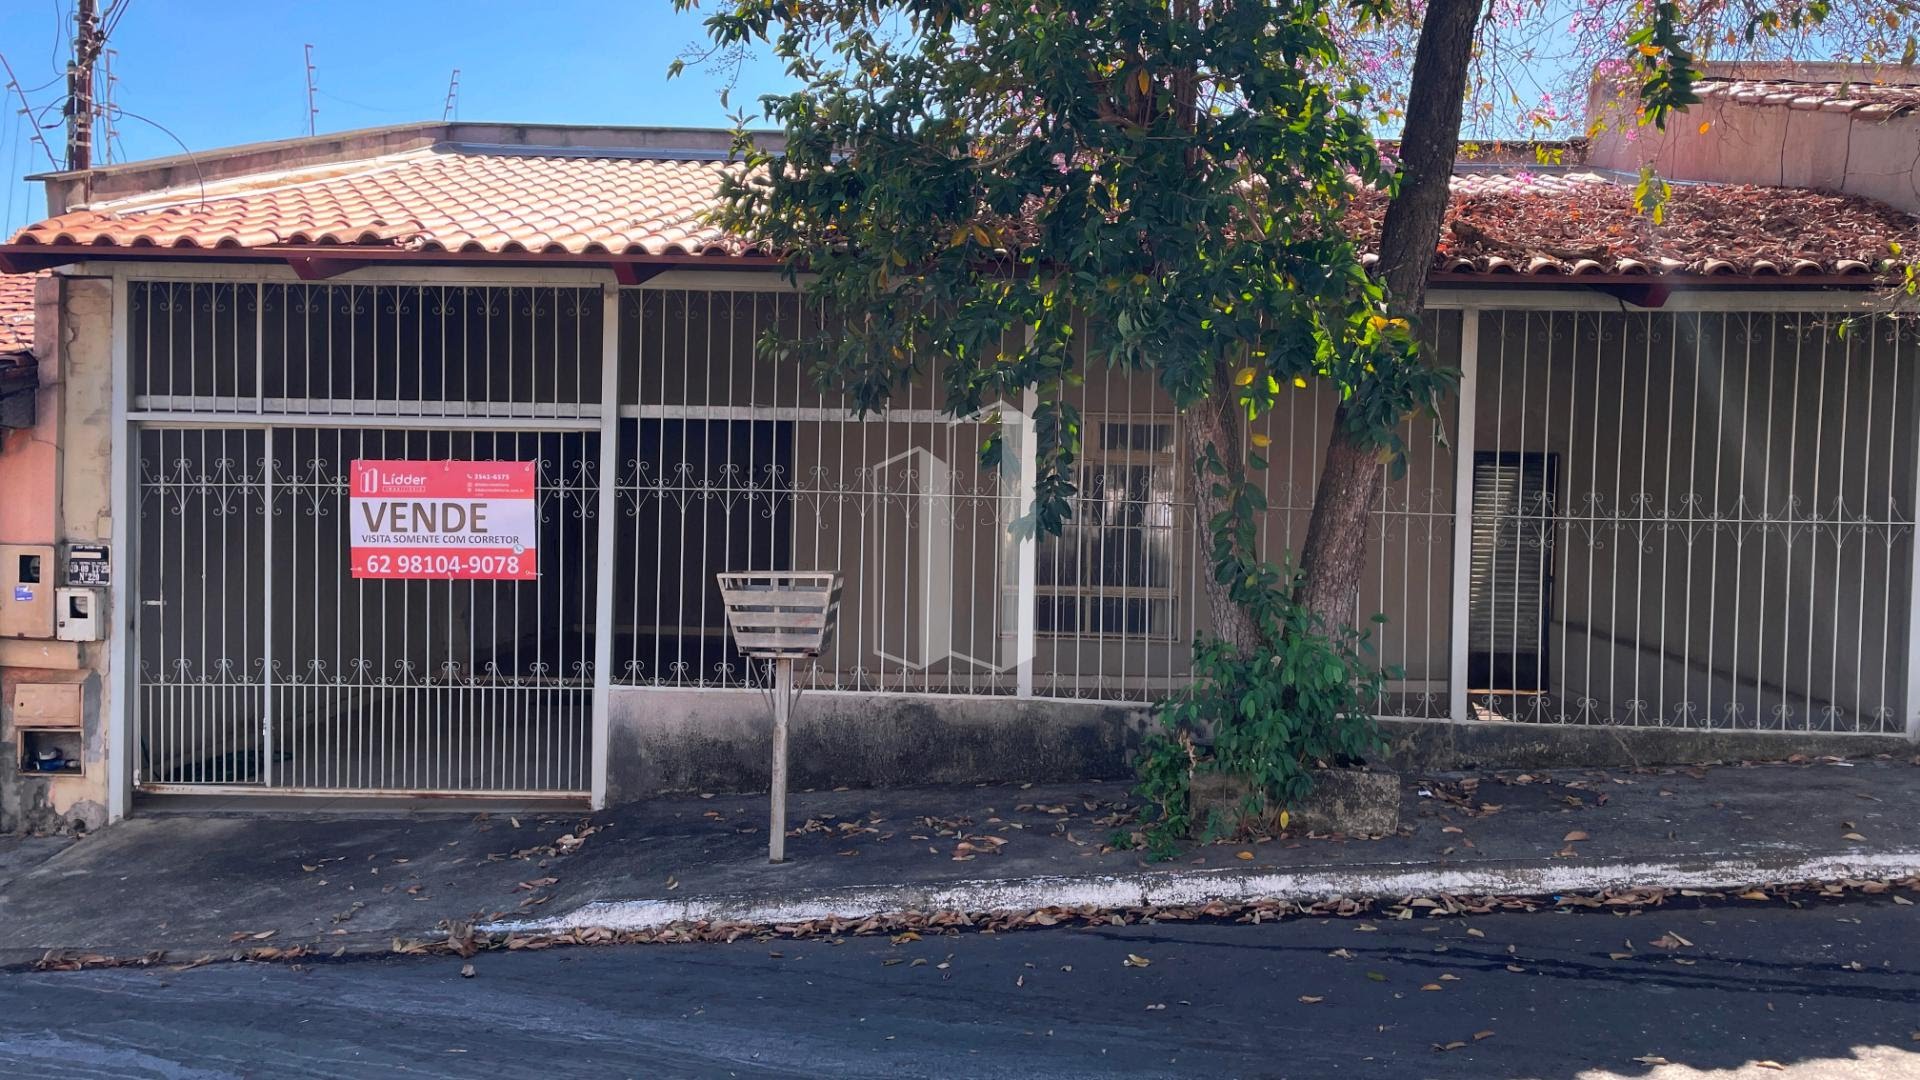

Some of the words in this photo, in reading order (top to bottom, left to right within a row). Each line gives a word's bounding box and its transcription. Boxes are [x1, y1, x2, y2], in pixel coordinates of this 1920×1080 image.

[383, 473, 427, 486] Lídder
[361, 502, 488, 533] VENDE
[361, 535, 391, 544] VISITA
[394, 535, 440, 544] SOMENTE
[443, 535, 466, 544] COM
[468, 535, 519, 544] CORRETOR
[367, 555, 391, 574] 62
[397, 555, 519, 574] 98104-9078
